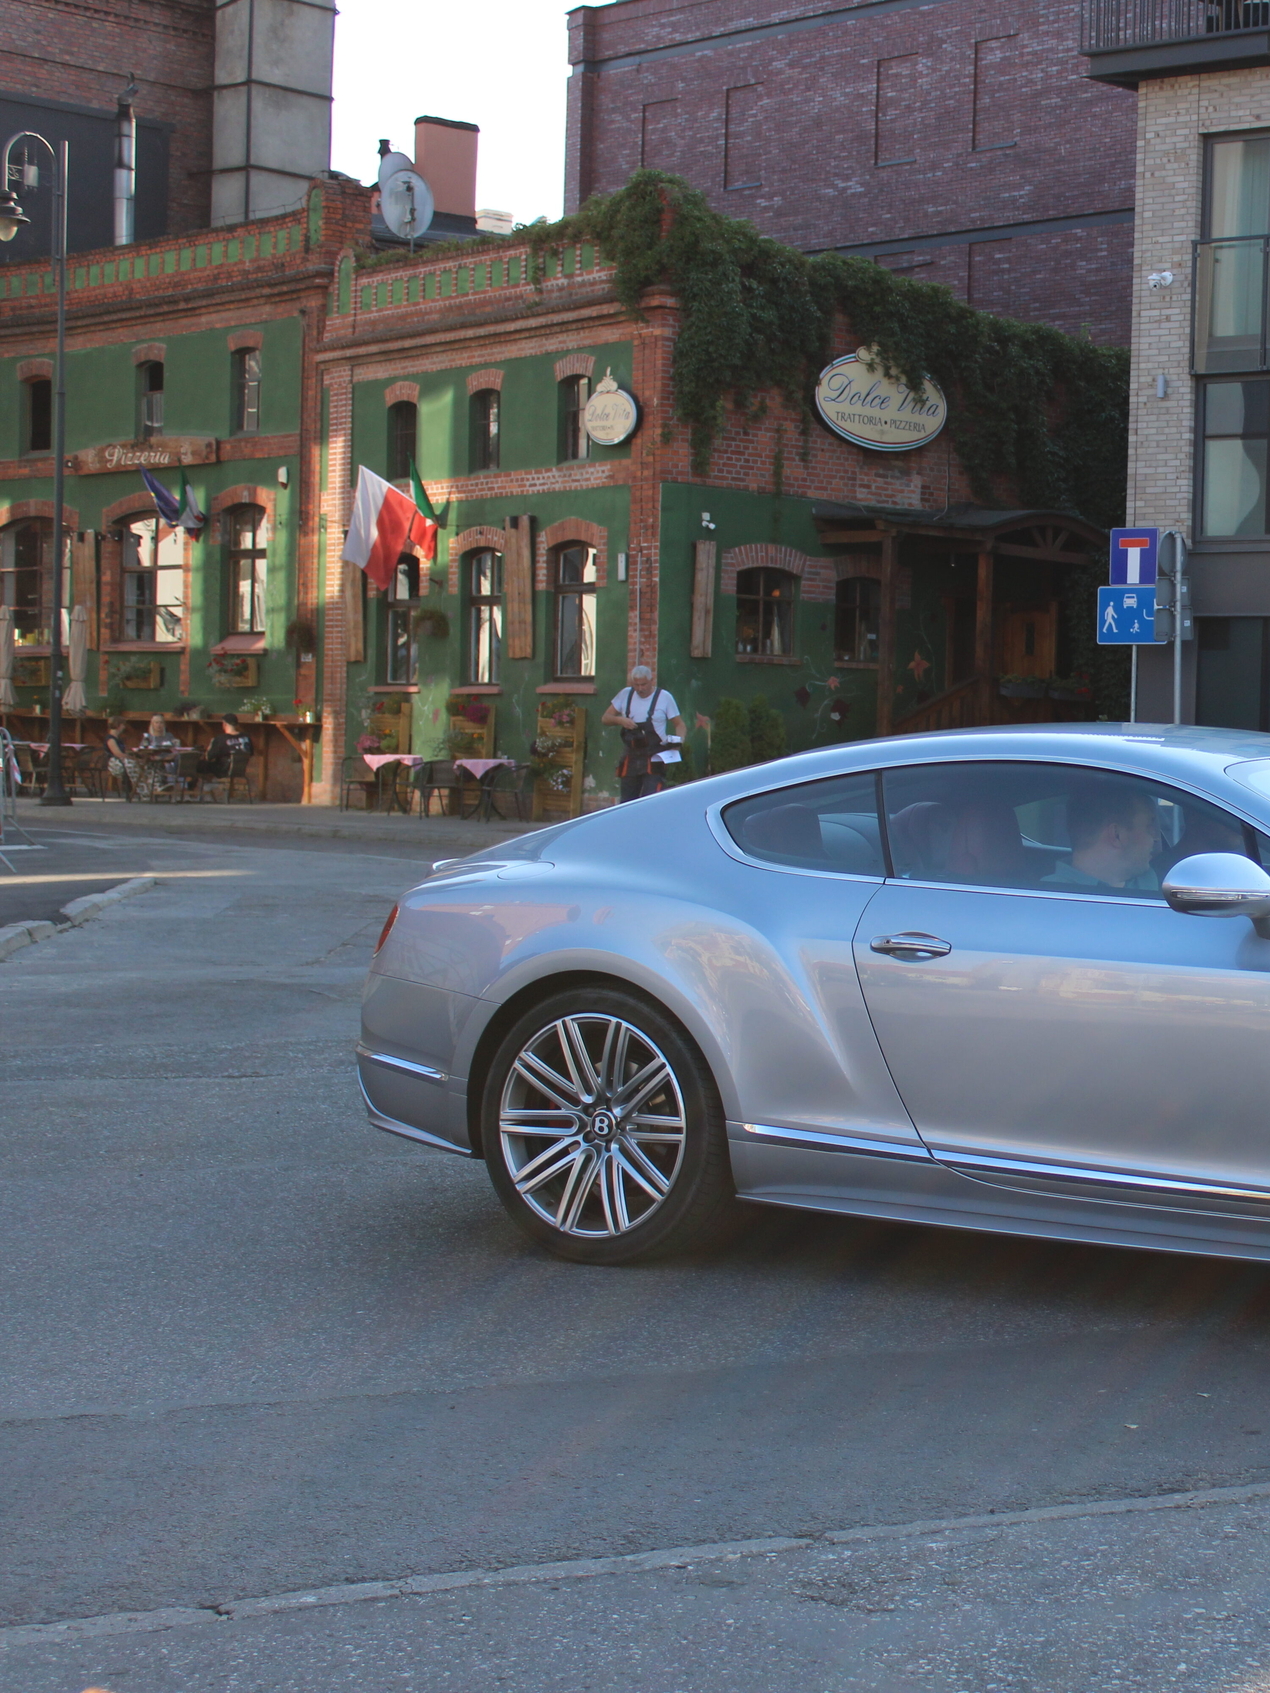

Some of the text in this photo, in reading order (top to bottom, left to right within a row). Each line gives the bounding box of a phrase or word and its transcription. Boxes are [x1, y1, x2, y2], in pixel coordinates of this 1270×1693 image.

[823, 373, 940, 418] Dolce Vita
[835, 411, 926, 433] TRATTORIA PIZZERIA
[105, 446, 170, 468] Pizzeria
[594, 1116, 609, 1135] B
